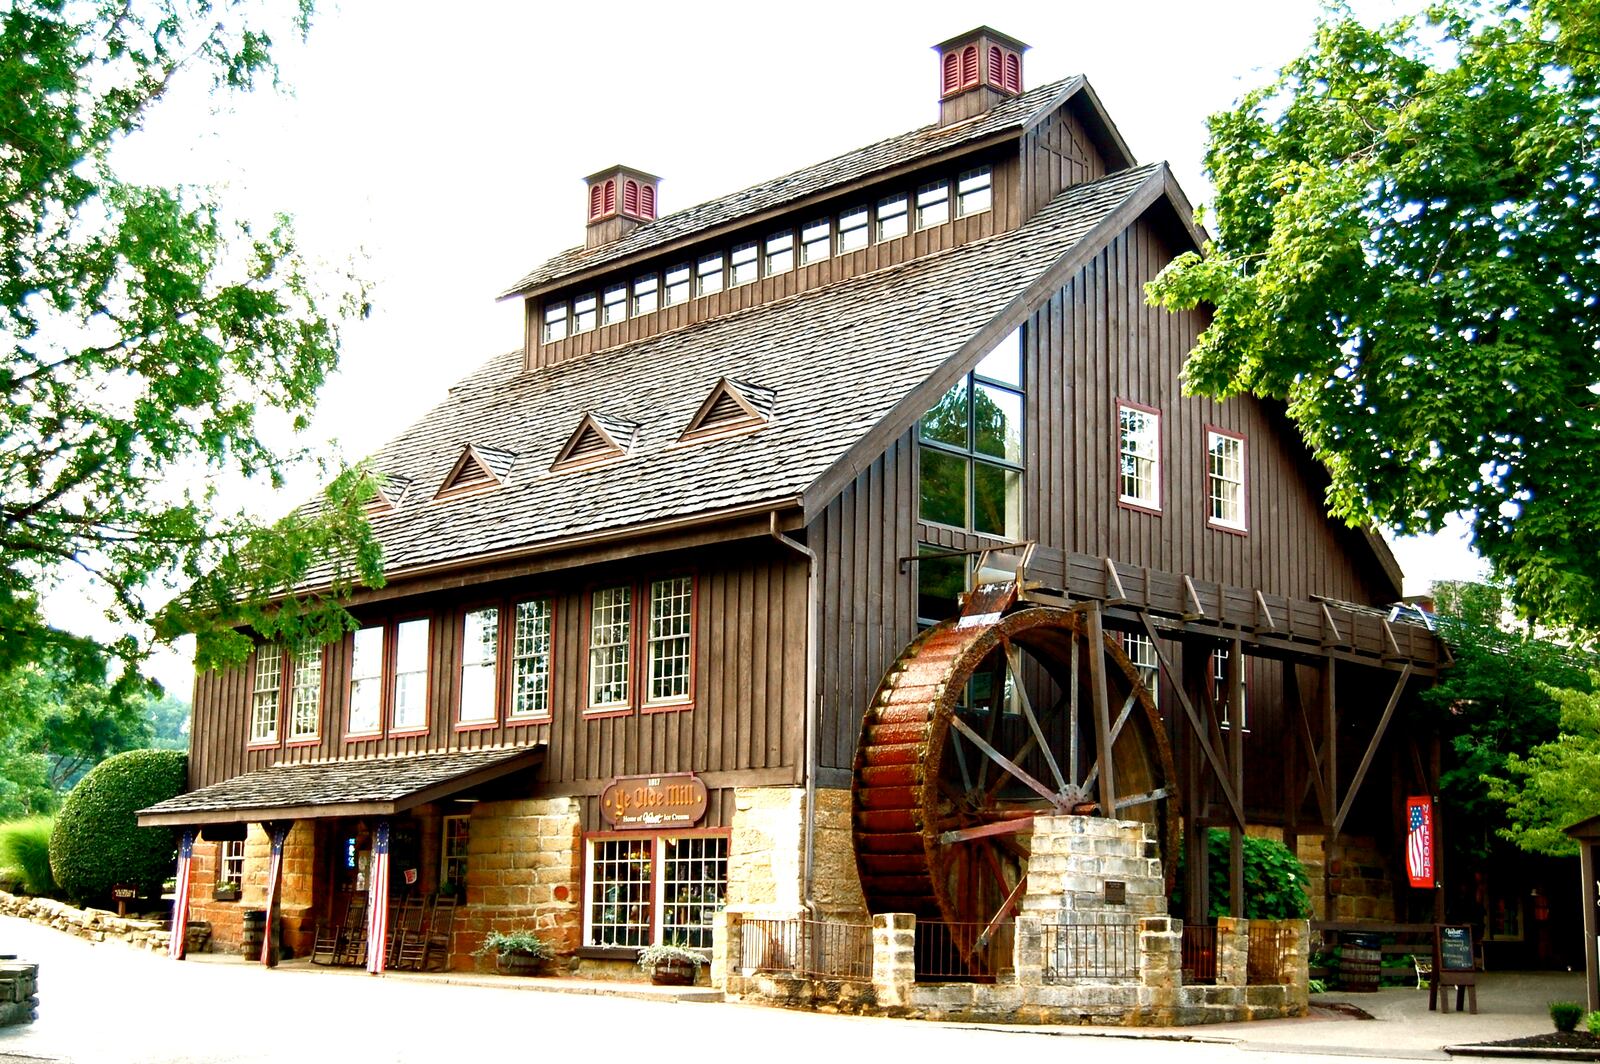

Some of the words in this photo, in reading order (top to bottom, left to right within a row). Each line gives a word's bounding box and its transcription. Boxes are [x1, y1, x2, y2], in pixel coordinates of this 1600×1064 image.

[615, 789, 631, 816] Ye
[634, 787, 663, 808] Olde
[666, 784, 694, 805] Mill
[1422, 804, 1431, 878] WELCOME
